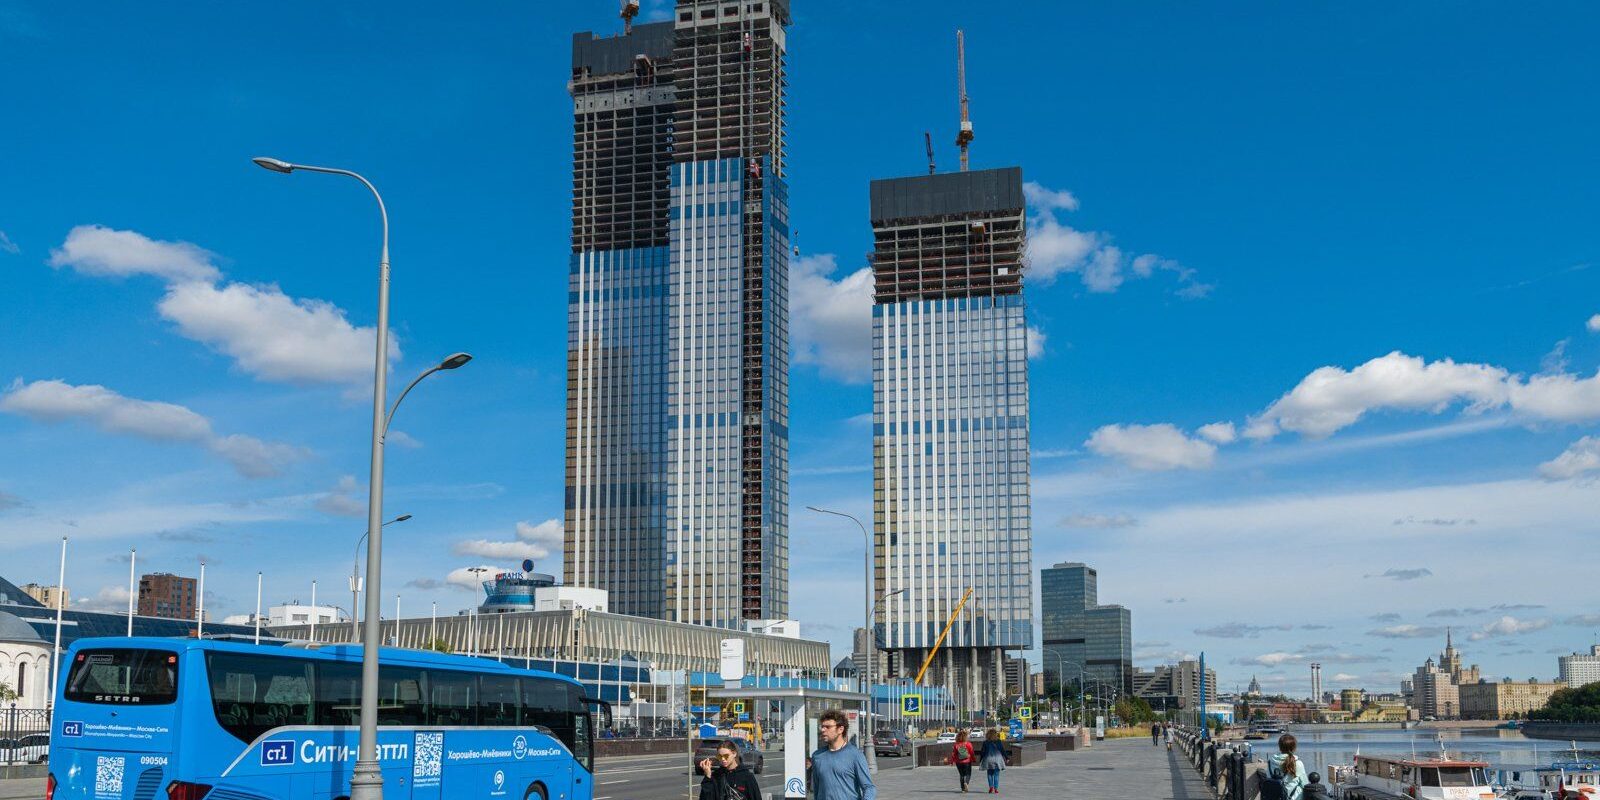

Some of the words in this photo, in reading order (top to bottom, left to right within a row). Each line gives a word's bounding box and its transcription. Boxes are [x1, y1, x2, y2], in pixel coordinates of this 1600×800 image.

[516, 740, 525, 750] 30
[300, 739, 408, 764] Сити-аттл
[527, 747, 561, 756] Москва-Сити
[140, 756, 168, 765] 090504
